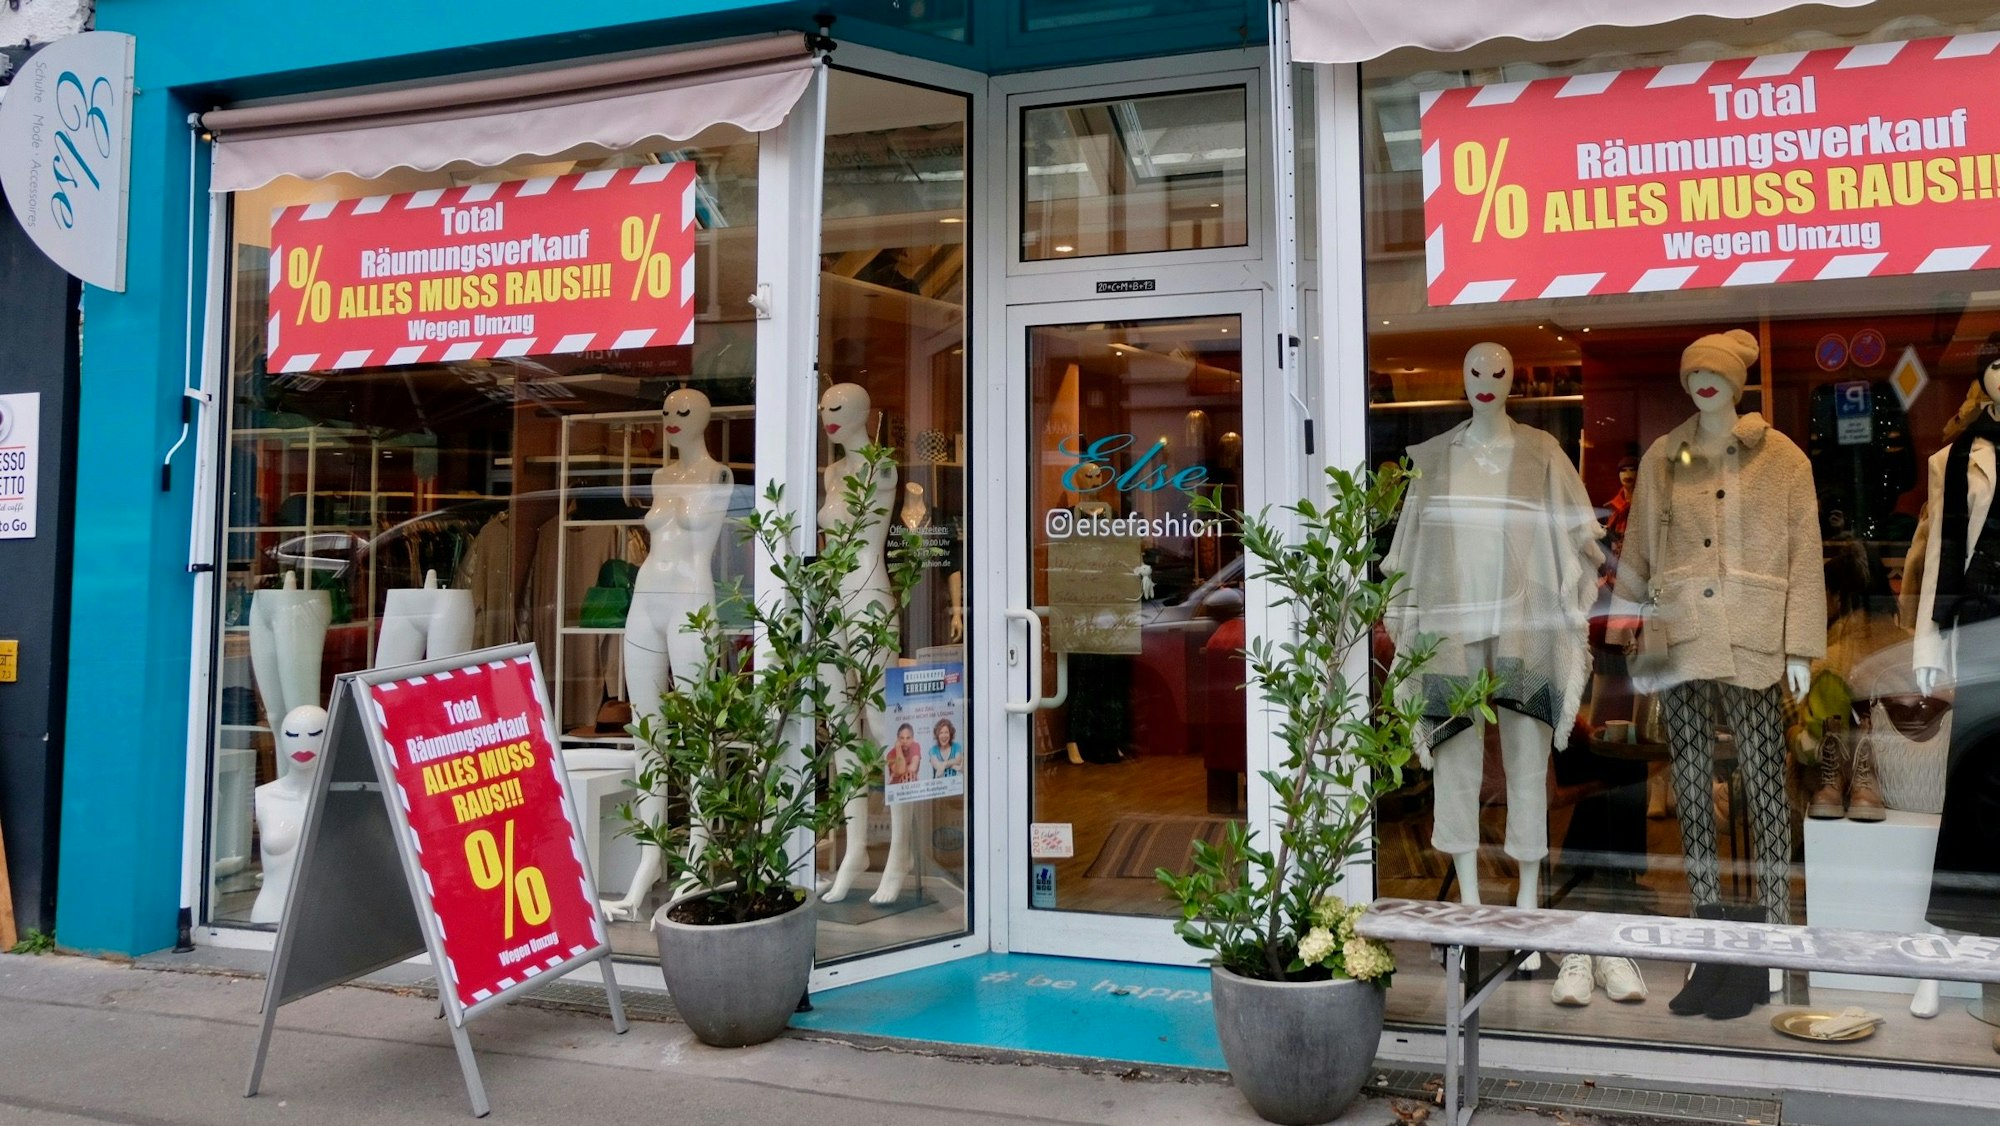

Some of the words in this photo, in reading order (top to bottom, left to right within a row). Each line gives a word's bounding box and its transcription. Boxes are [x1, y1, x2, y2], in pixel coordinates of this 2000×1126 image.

[35, 61, 47, 103] Schuhe
[1708, 75, 1817, 122] Total
[32, 114, 44, 148] Mode
[51, 70, 115, 231] Else
[1576, 107, 1968, 180] Räumungsverkauf
[28, 159, 42, 228] Accessoires
[1453, 137, 1528, 243] %
[1543, 182, 1669, 234] ALLES
[1679, 169, 1815, 222] MUSS
[440, 201, 503, 237] Total
[1663, 228, 1770, 261] Wegen
[1777, 221, 1881, 254] Umzug
[361, 228, 589, 279] Räumungsverkauf
[620, 213, 671, 301] %
[288, 244, 331, 325] %
[338, 274, 412, 320] ALLES
[418, 269, 500, 315] MUSS
[504, 262, 611, 307] RAUS!!!
[407, 316, 470, 342] Wegen
[473, 311, 534, 339] Umzug
[1058, 433, 1209, 493] Else
[12, 519, 27, 531] Go
[443, 695, 481, 725] Total
[407, 712, 529, 764] Räumungsverkauf
[422, 759, 480, 796] ALLES
[480, 740, 535, 780] MUSS
[452, 777, 524, 823] RAUS!!!
[464, 819, 551, 940] %
[499, 947, 531, 967] Wegen
[528, 931, 559, 954] Umzug
[1026, 975, 1076, 989] be
